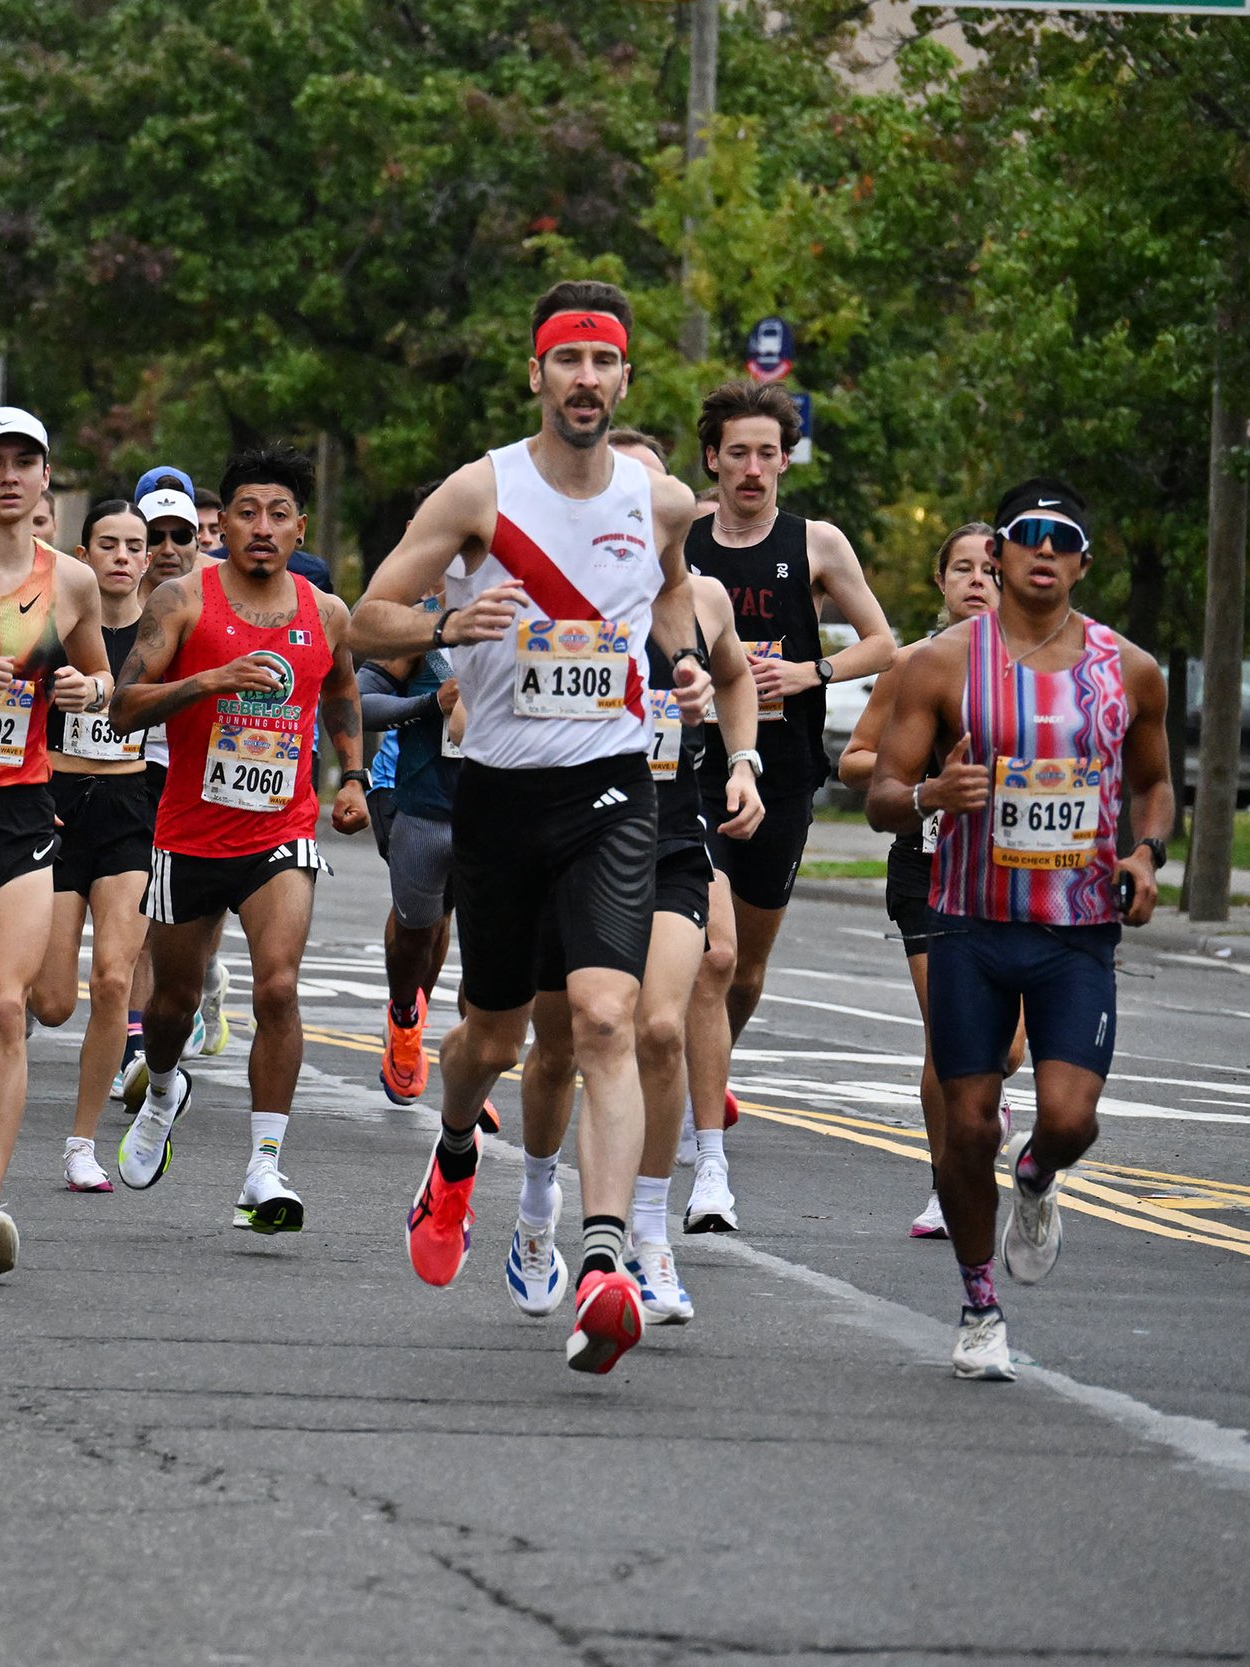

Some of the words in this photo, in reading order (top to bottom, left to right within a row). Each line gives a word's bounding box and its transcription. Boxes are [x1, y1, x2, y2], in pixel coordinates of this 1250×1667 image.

[521, 668, 541, 694] A
[552, 666, 611, 697] 1308
[217, 698, 302, 720] REBELDES
[72, 718, 79, 728] A
[219, 715, 268, 727] RUNNING
[275, 720, 299, 730] CLUB
[71, 728, 79, 738] A
[0, 746, 17, 755] WAVE
[210, 762, 226, 785] A
[232, 765, 284, 795] 2060
[269, 797, 286, 805] WAVE
[1002, 802, 1018, 827] B
[1028, 801, 1085, 831] 6197
[1002, 855, 1019, 863] BAG
[1021, 856, 1050, 865] CHECK
[1054, 854, 1080, 868] 6197
